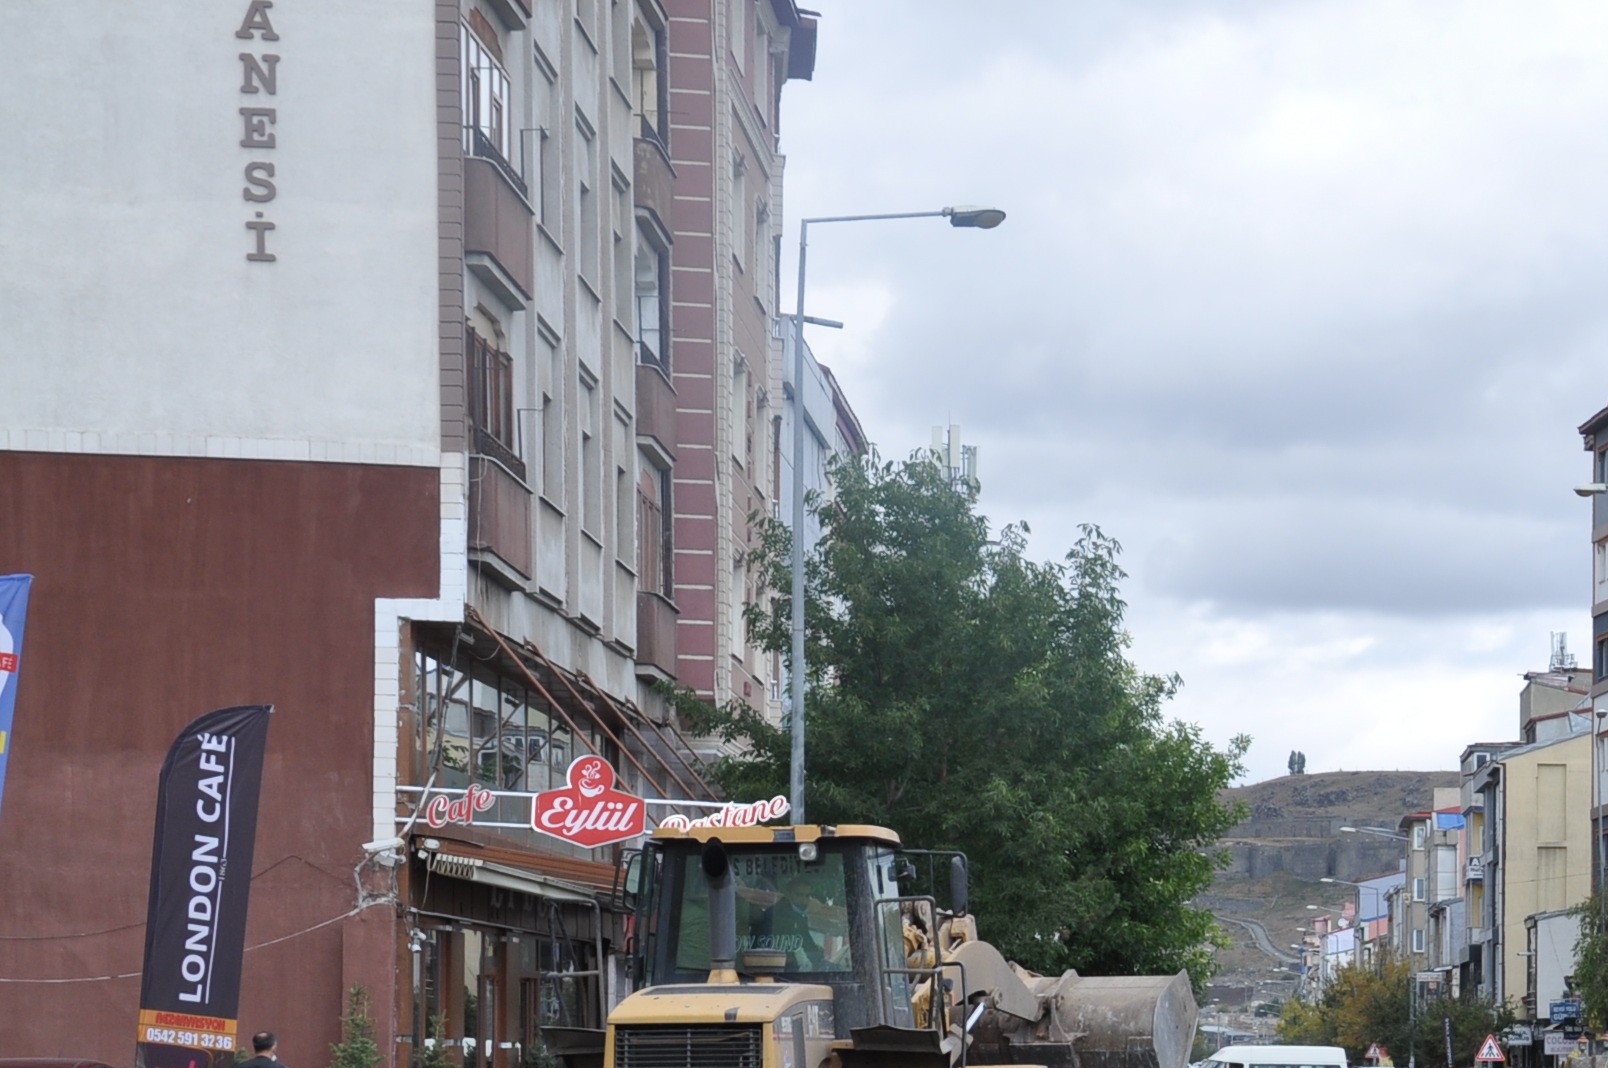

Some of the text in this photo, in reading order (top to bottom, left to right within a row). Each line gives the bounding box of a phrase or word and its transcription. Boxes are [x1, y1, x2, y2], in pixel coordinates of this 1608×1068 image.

[427, 783, 496, 829] Cafe
[541, 796, 639, 836] Eylül
[178, 732, 230, 1003] LONDON CAFÉ
[147, 1028, 176, 1043] 0542
[177, 1031, 198, 1045] 591
